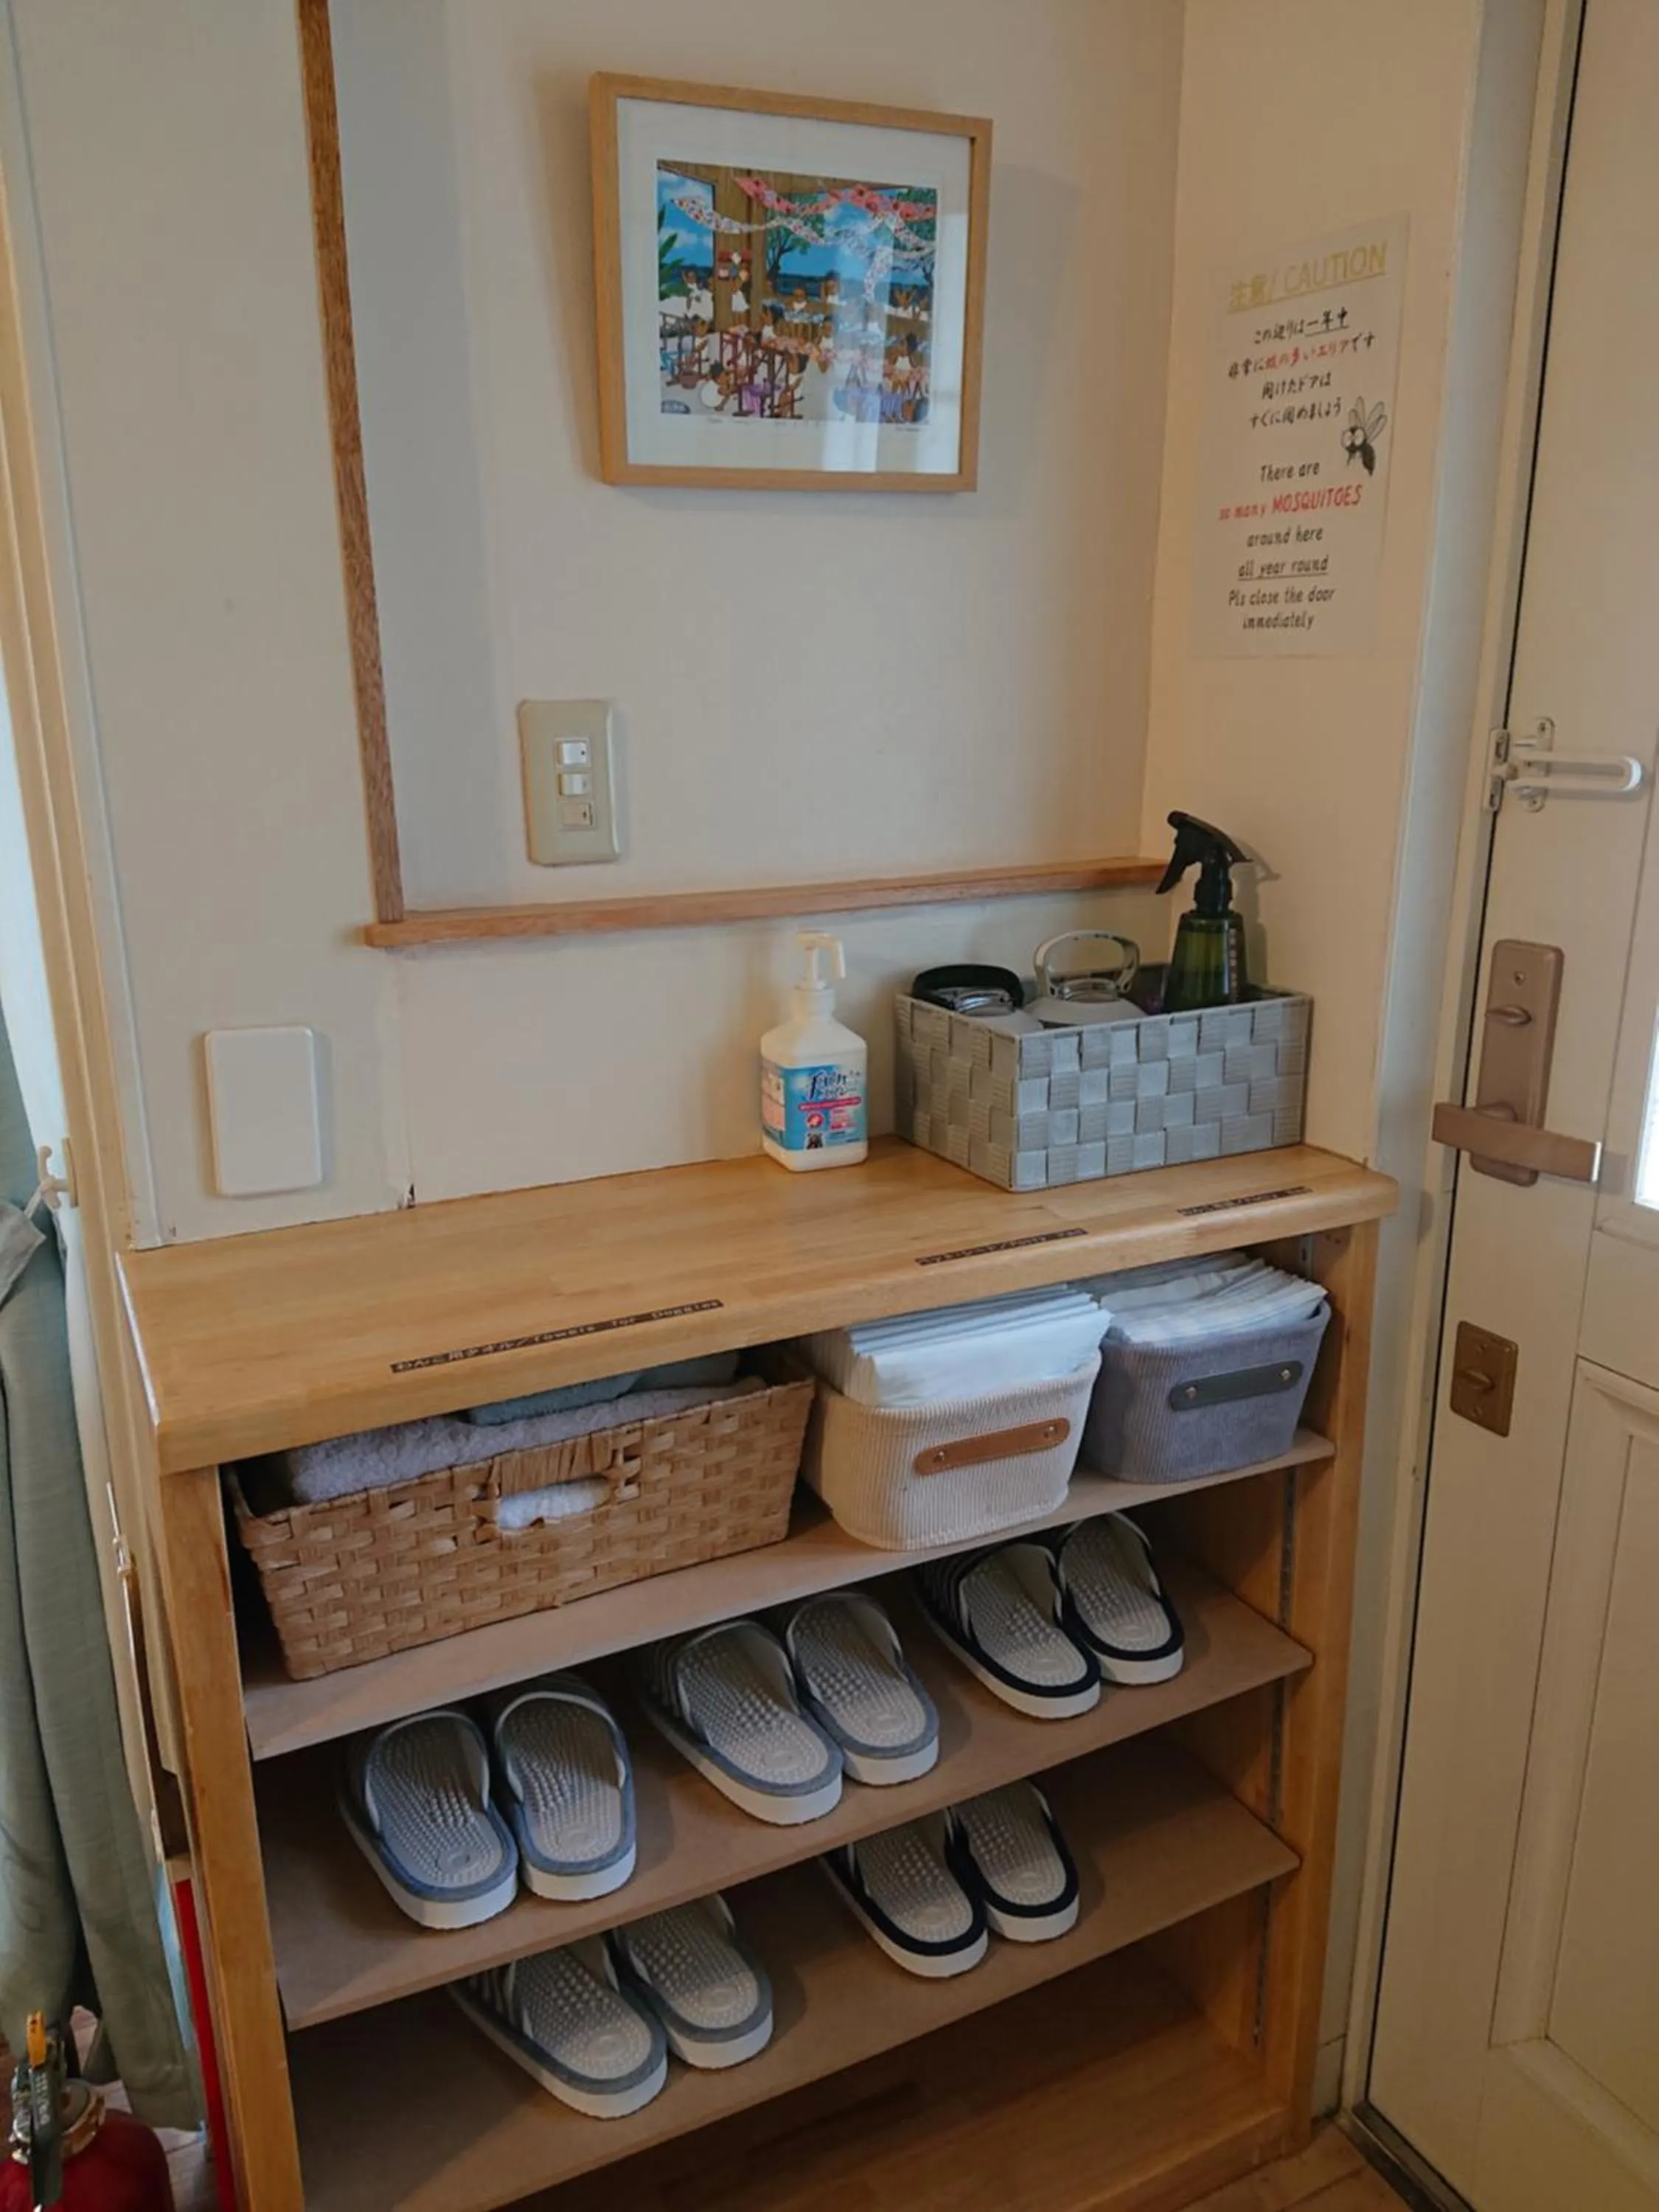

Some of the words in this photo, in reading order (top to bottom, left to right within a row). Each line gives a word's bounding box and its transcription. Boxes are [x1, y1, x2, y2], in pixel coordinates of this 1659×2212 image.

[1284, 240, 1388, 293] CAUTION
[1260, 464, 1294, 482] There
[1298, 462, 1321, 478] are
[1219, 507, 1230, 520] so
[1234, 503, 1267, 518] many
[1273, 484, 1363, 513] MOSQUITOES
[1247, 526, 1291, 548] around
[1295, 525, 1324, 543] here
[1239, 560, 1254, 577] all
[1258, 563, 1285, 580] year
[1291, 554, 1329, 572] round
[1228, 589, 1246, 606] Pls
[1249, 588, 1279, 606] close
[1284, 585, 1303, 603] the
[1308, 585, 1337, 602] door
[1242, 611, 1315, 630] immediately
